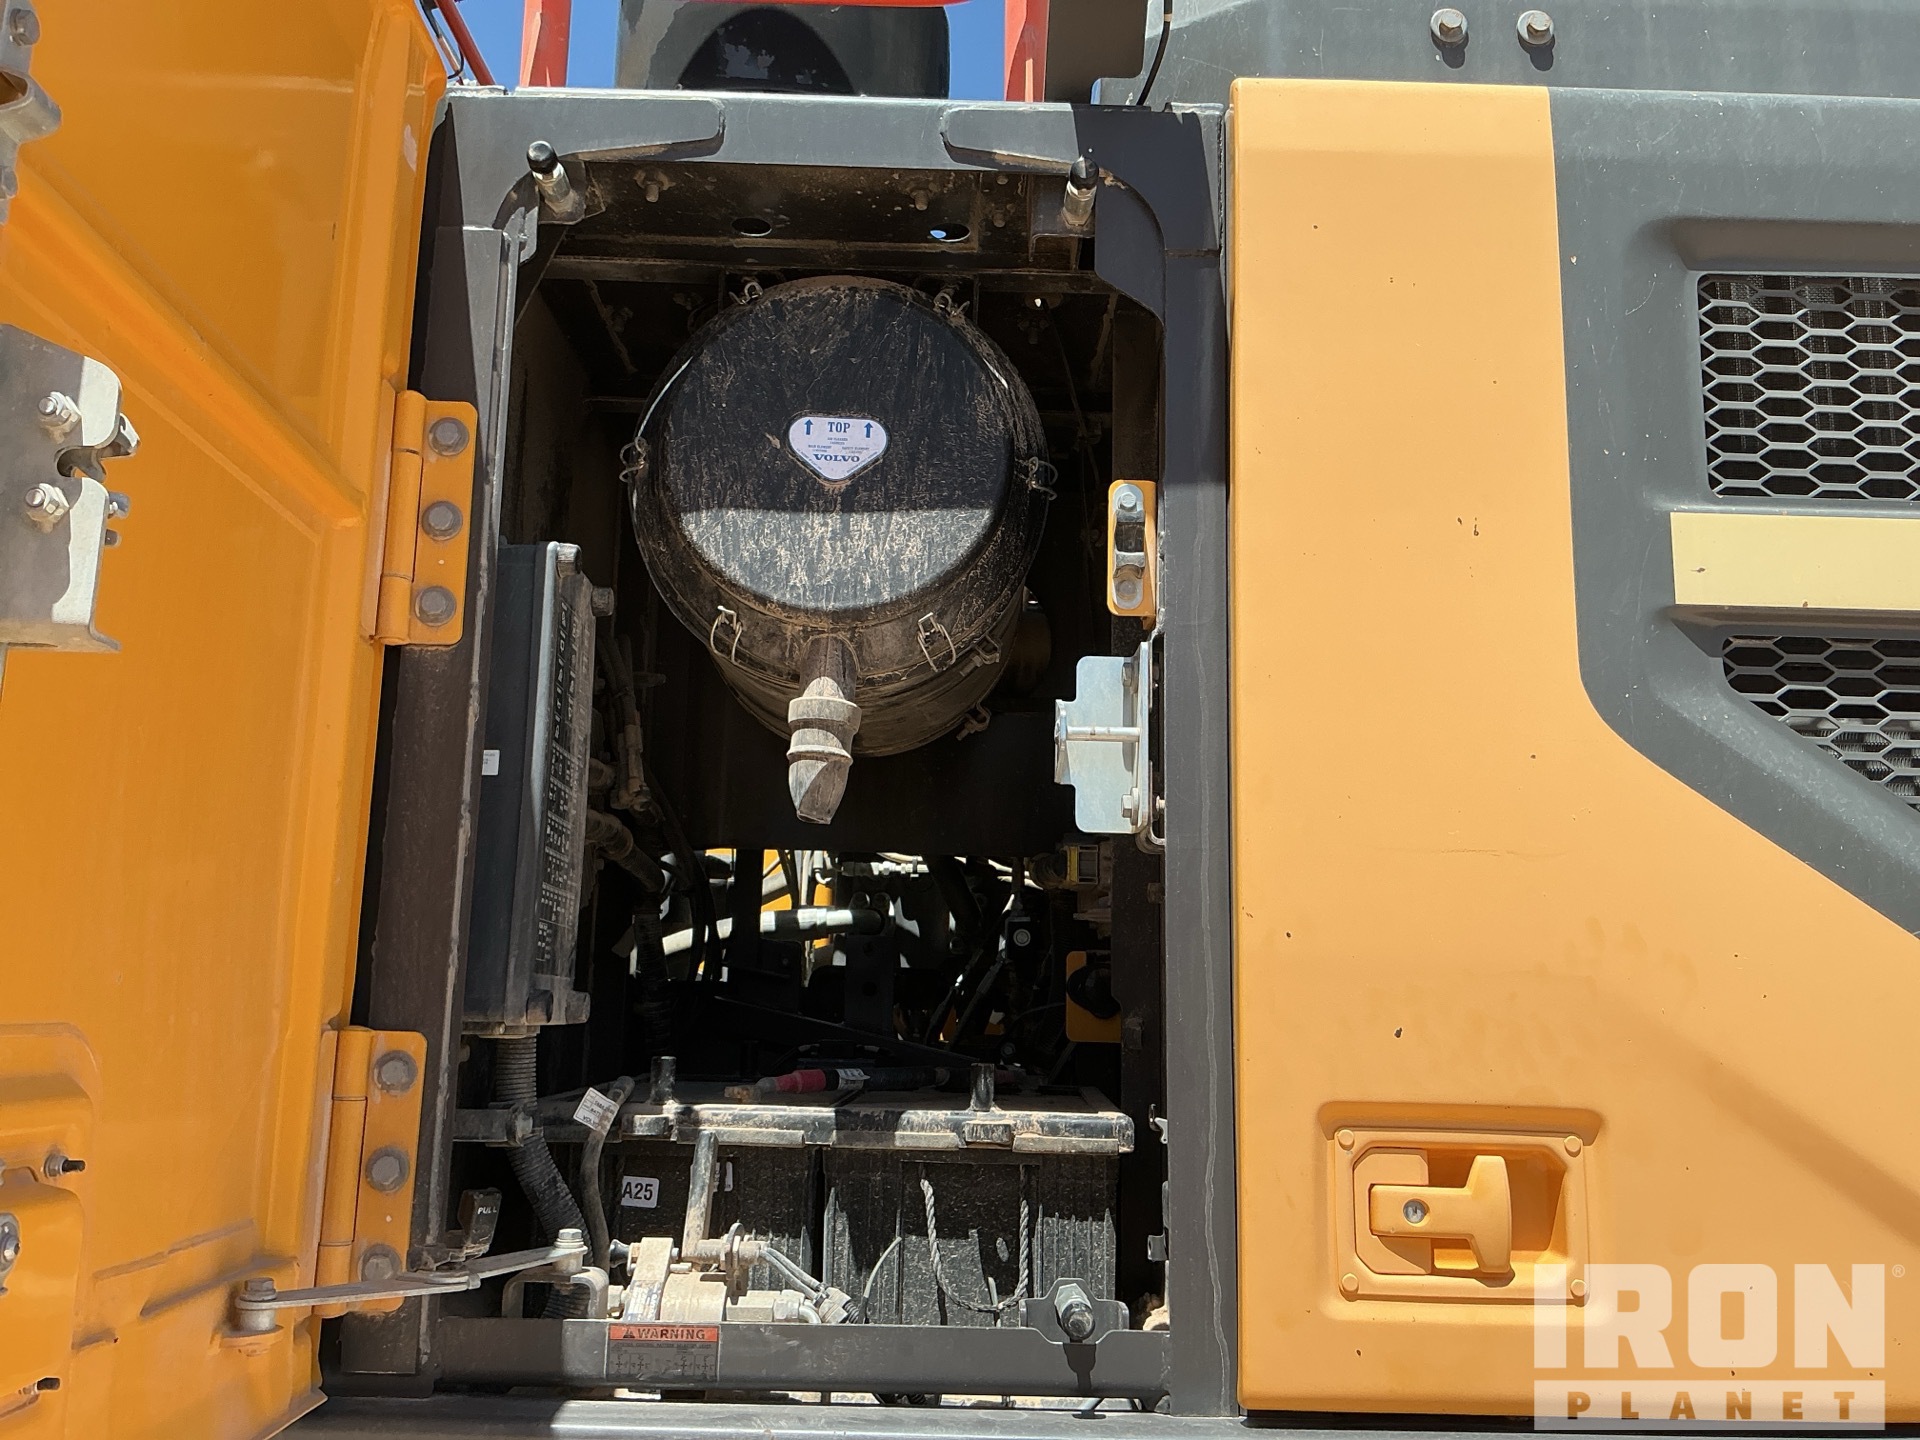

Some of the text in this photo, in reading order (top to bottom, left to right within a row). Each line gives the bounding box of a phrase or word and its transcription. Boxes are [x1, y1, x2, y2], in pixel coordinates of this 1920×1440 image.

[828, 421, 851, 433] TOP
[813, 453, 860, 462] VOLVO
[622, 1181, 653, 1201] A25
[477, 1206, 497, 1215] PULL
[638, 1328, 705, 1340] WARNING
